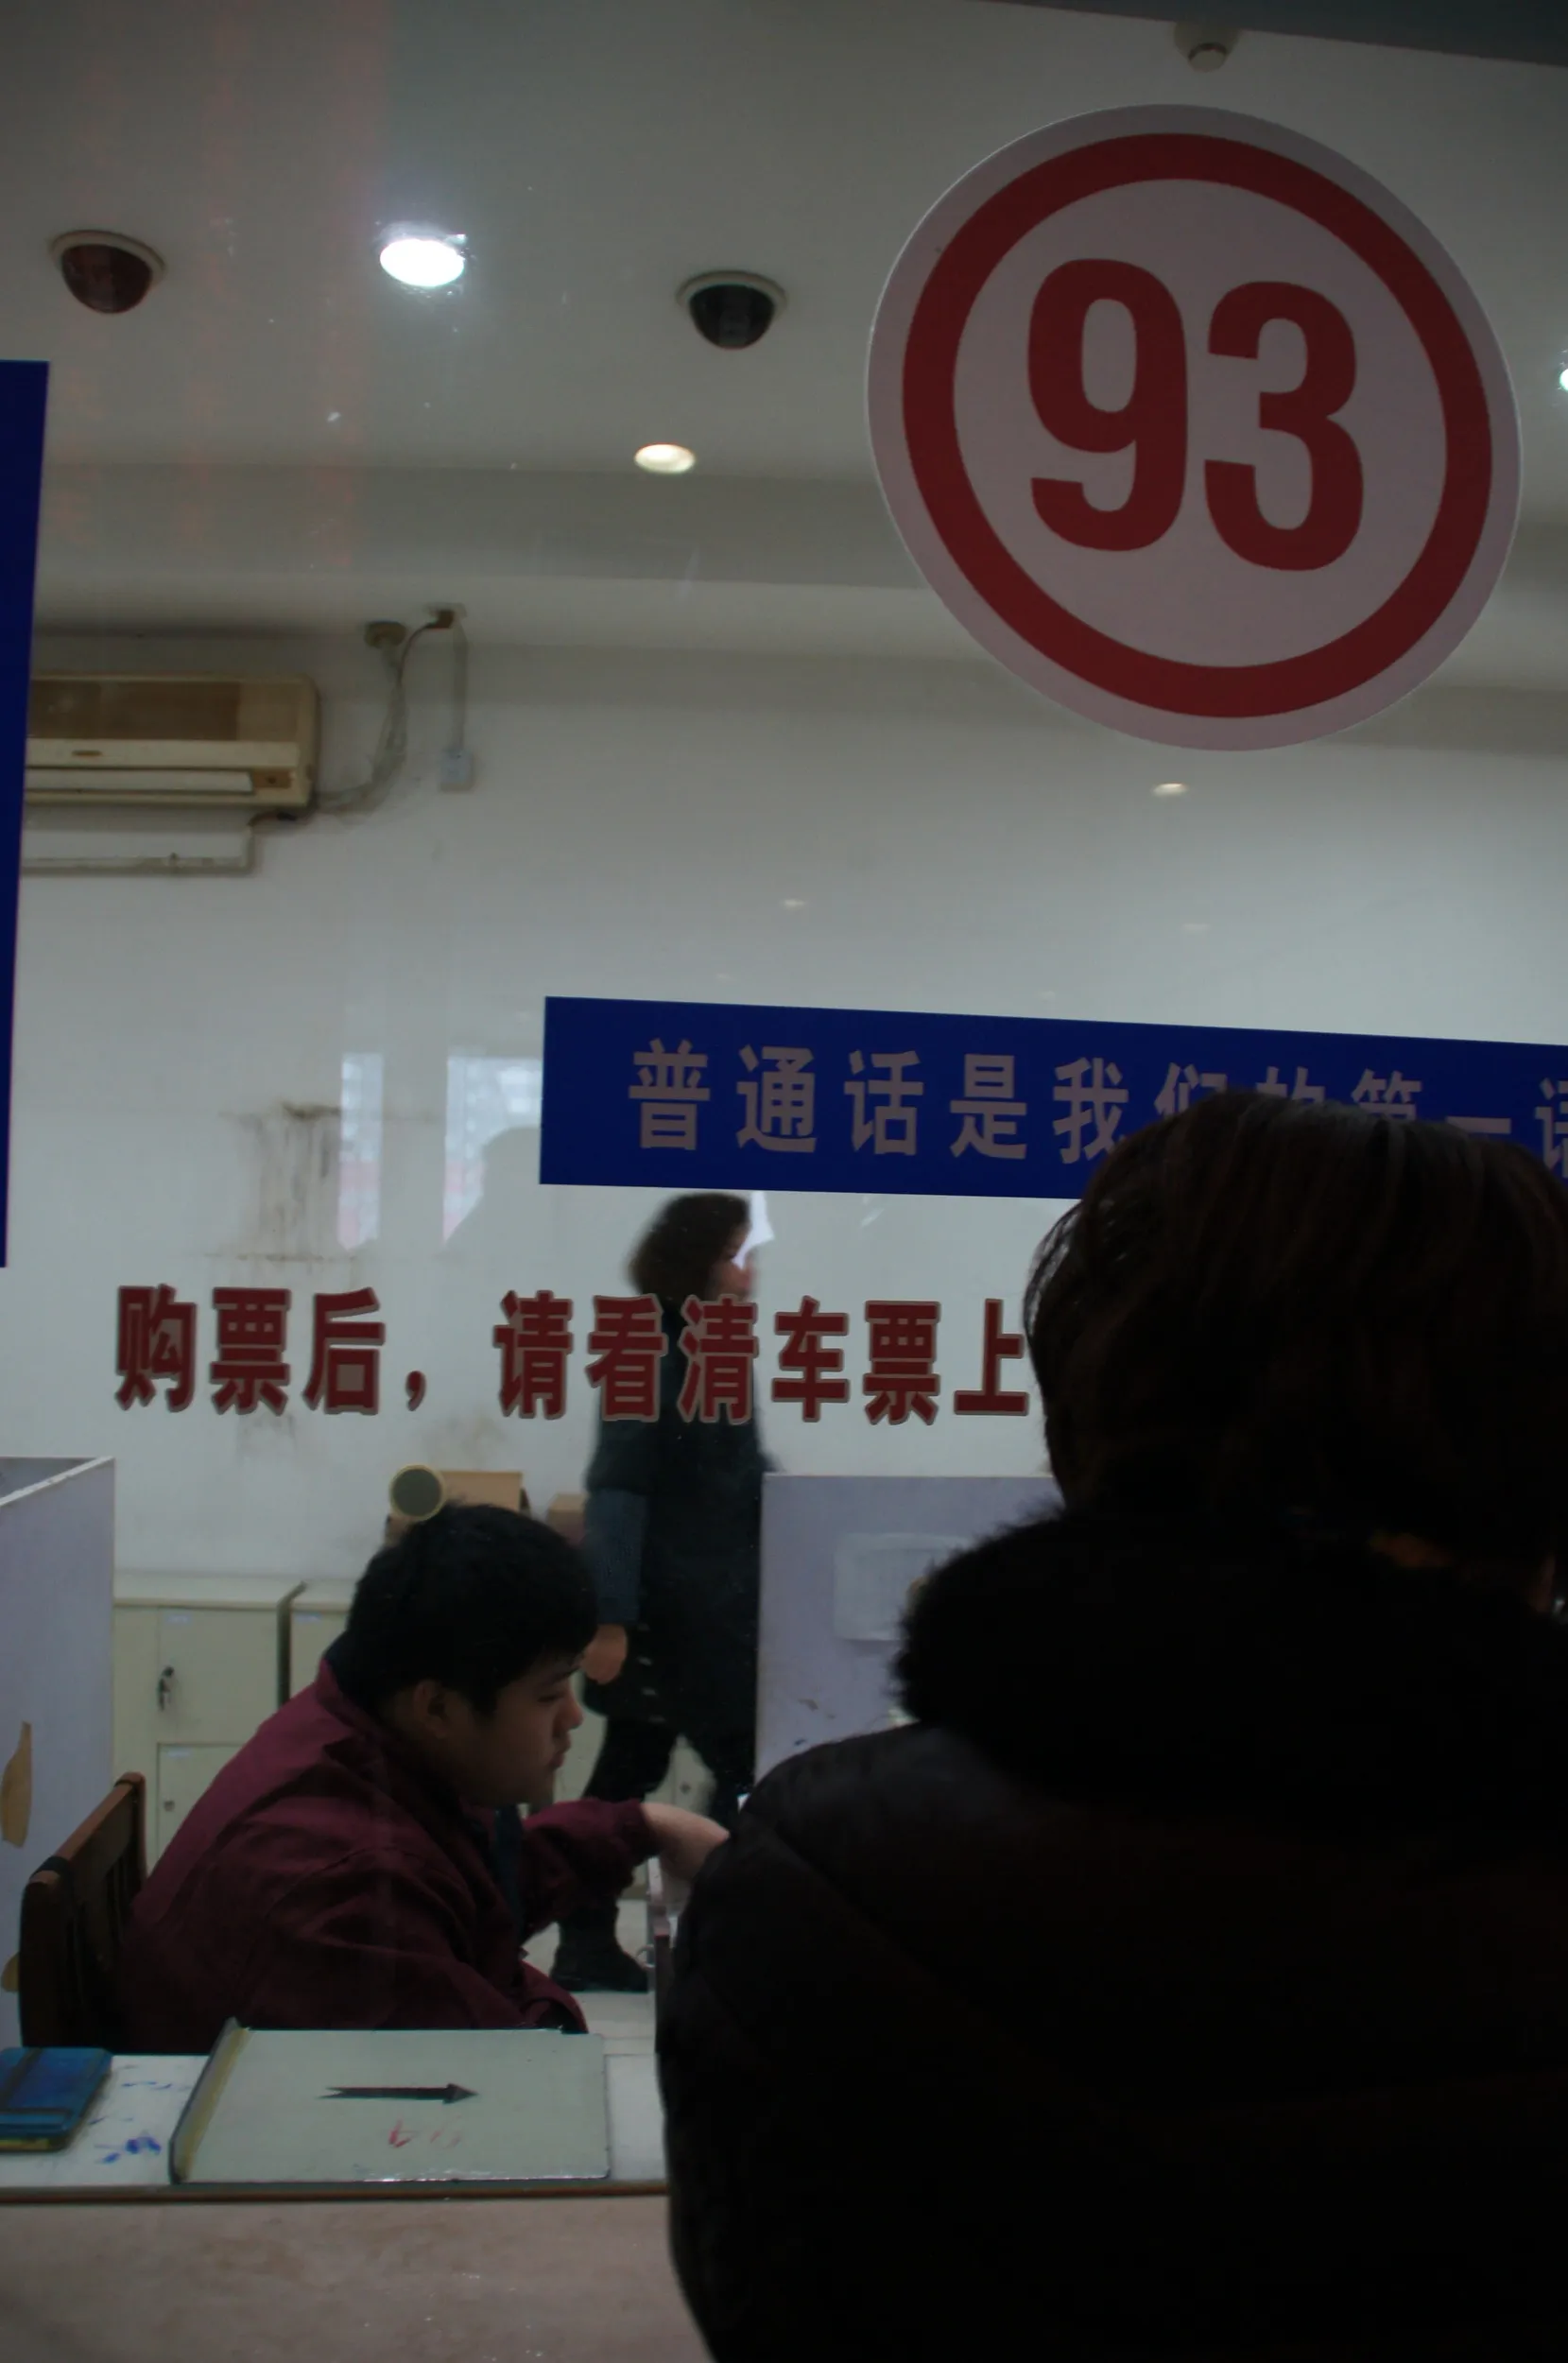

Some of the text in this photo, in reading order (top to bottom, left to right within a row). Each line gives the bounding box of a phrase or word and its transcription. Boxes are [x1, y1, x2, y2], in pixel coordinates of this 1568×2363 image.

[1027, 258, 1363, 572] 93
[628, 1037, 1568, 1179] 普通话是我一
